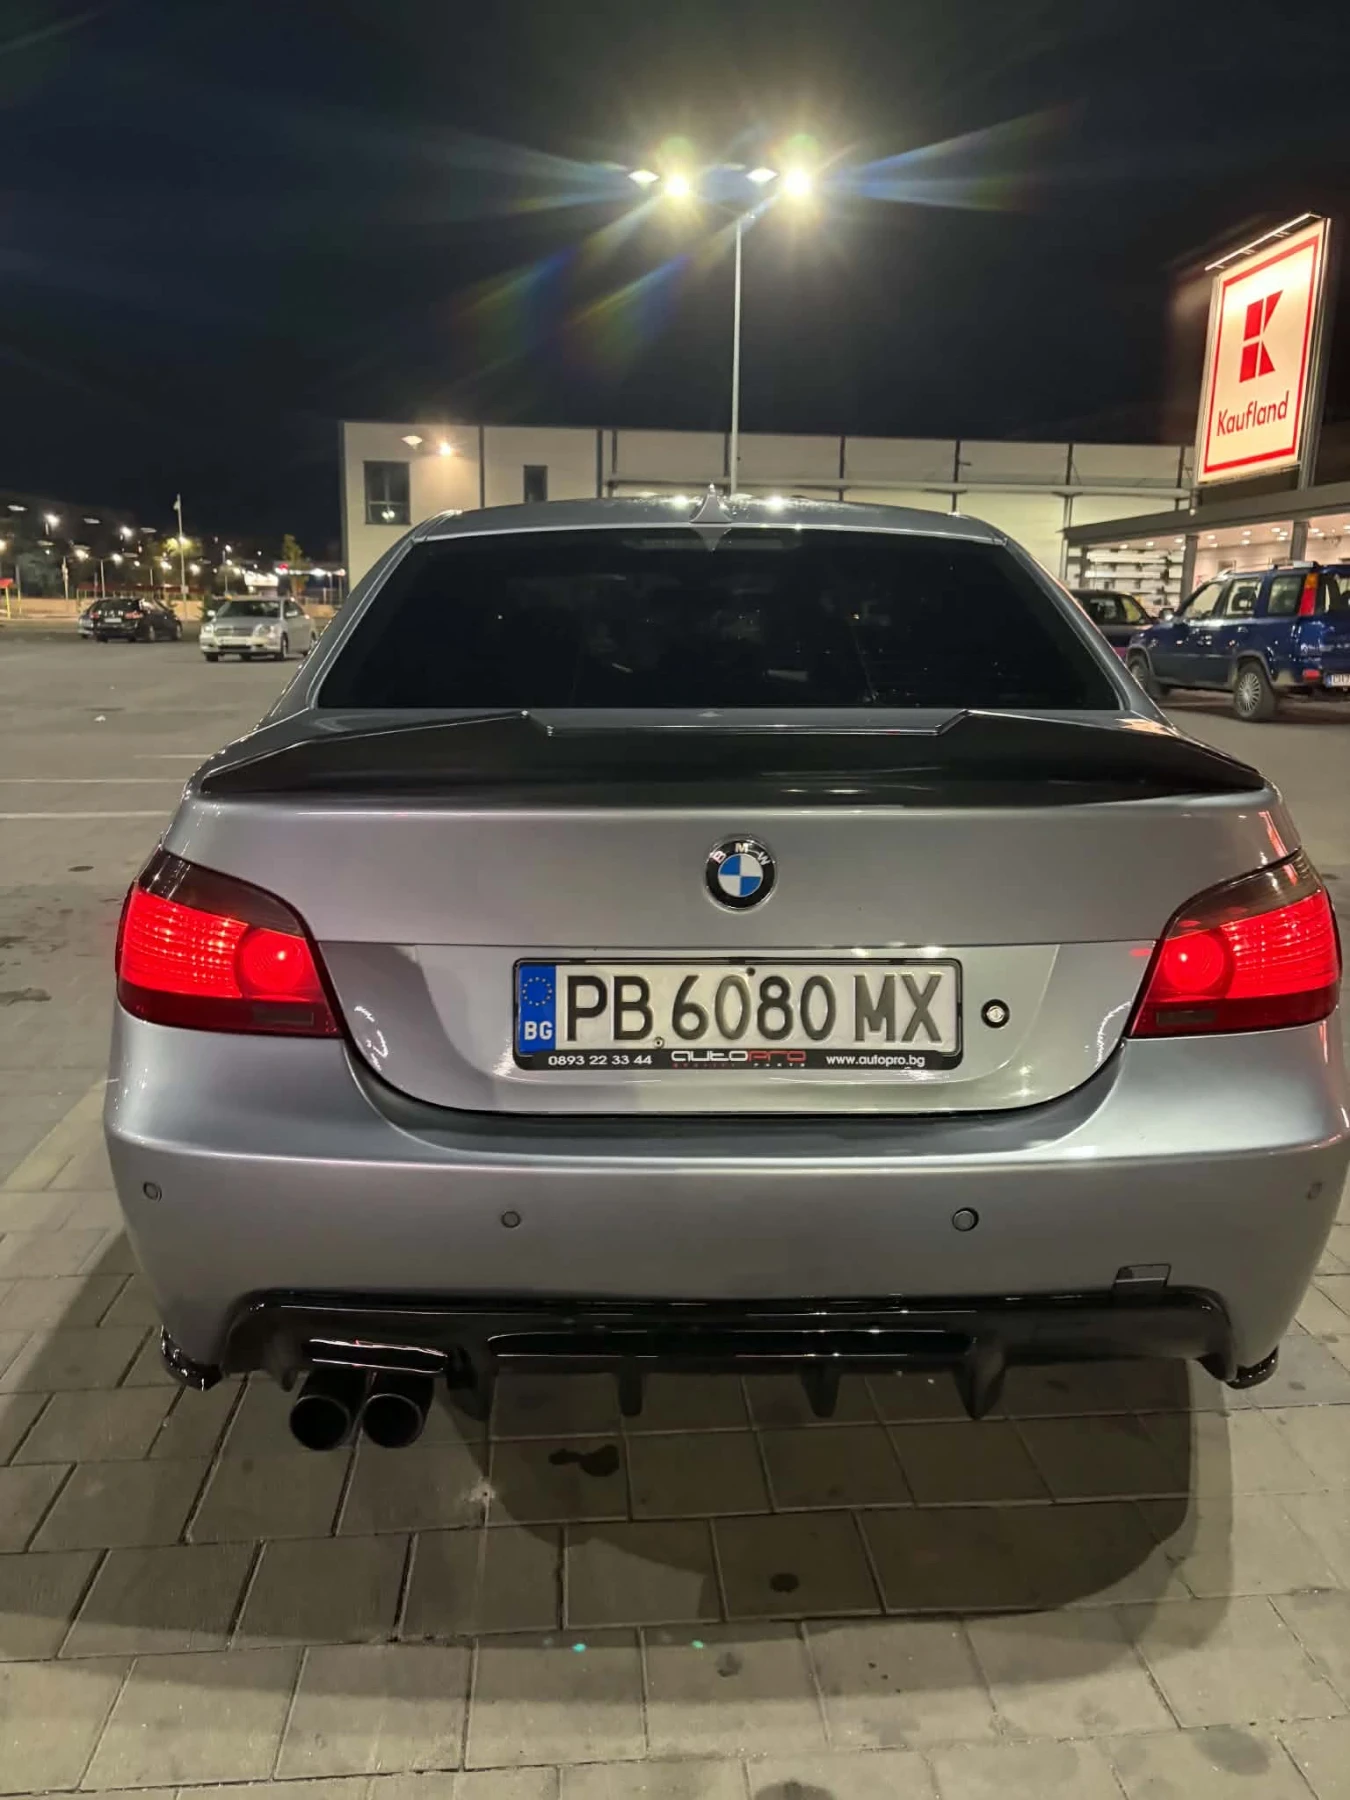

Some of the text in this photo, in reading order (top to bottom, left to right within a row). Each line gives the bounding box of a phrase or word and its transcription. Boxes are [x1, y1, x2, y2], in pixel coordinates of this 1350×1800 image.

[1216, 389, 1290, 437] Kaufland
[710, 842, 771, 866] BMW
[567, 973, 943, 1043] PB 6080 MX
[524, 1020, 553, 1041] BG
[547, 1054, 653, 1066] 0893 22 33 44
[826, 1054, 926, 1068] www.autopro.bg
